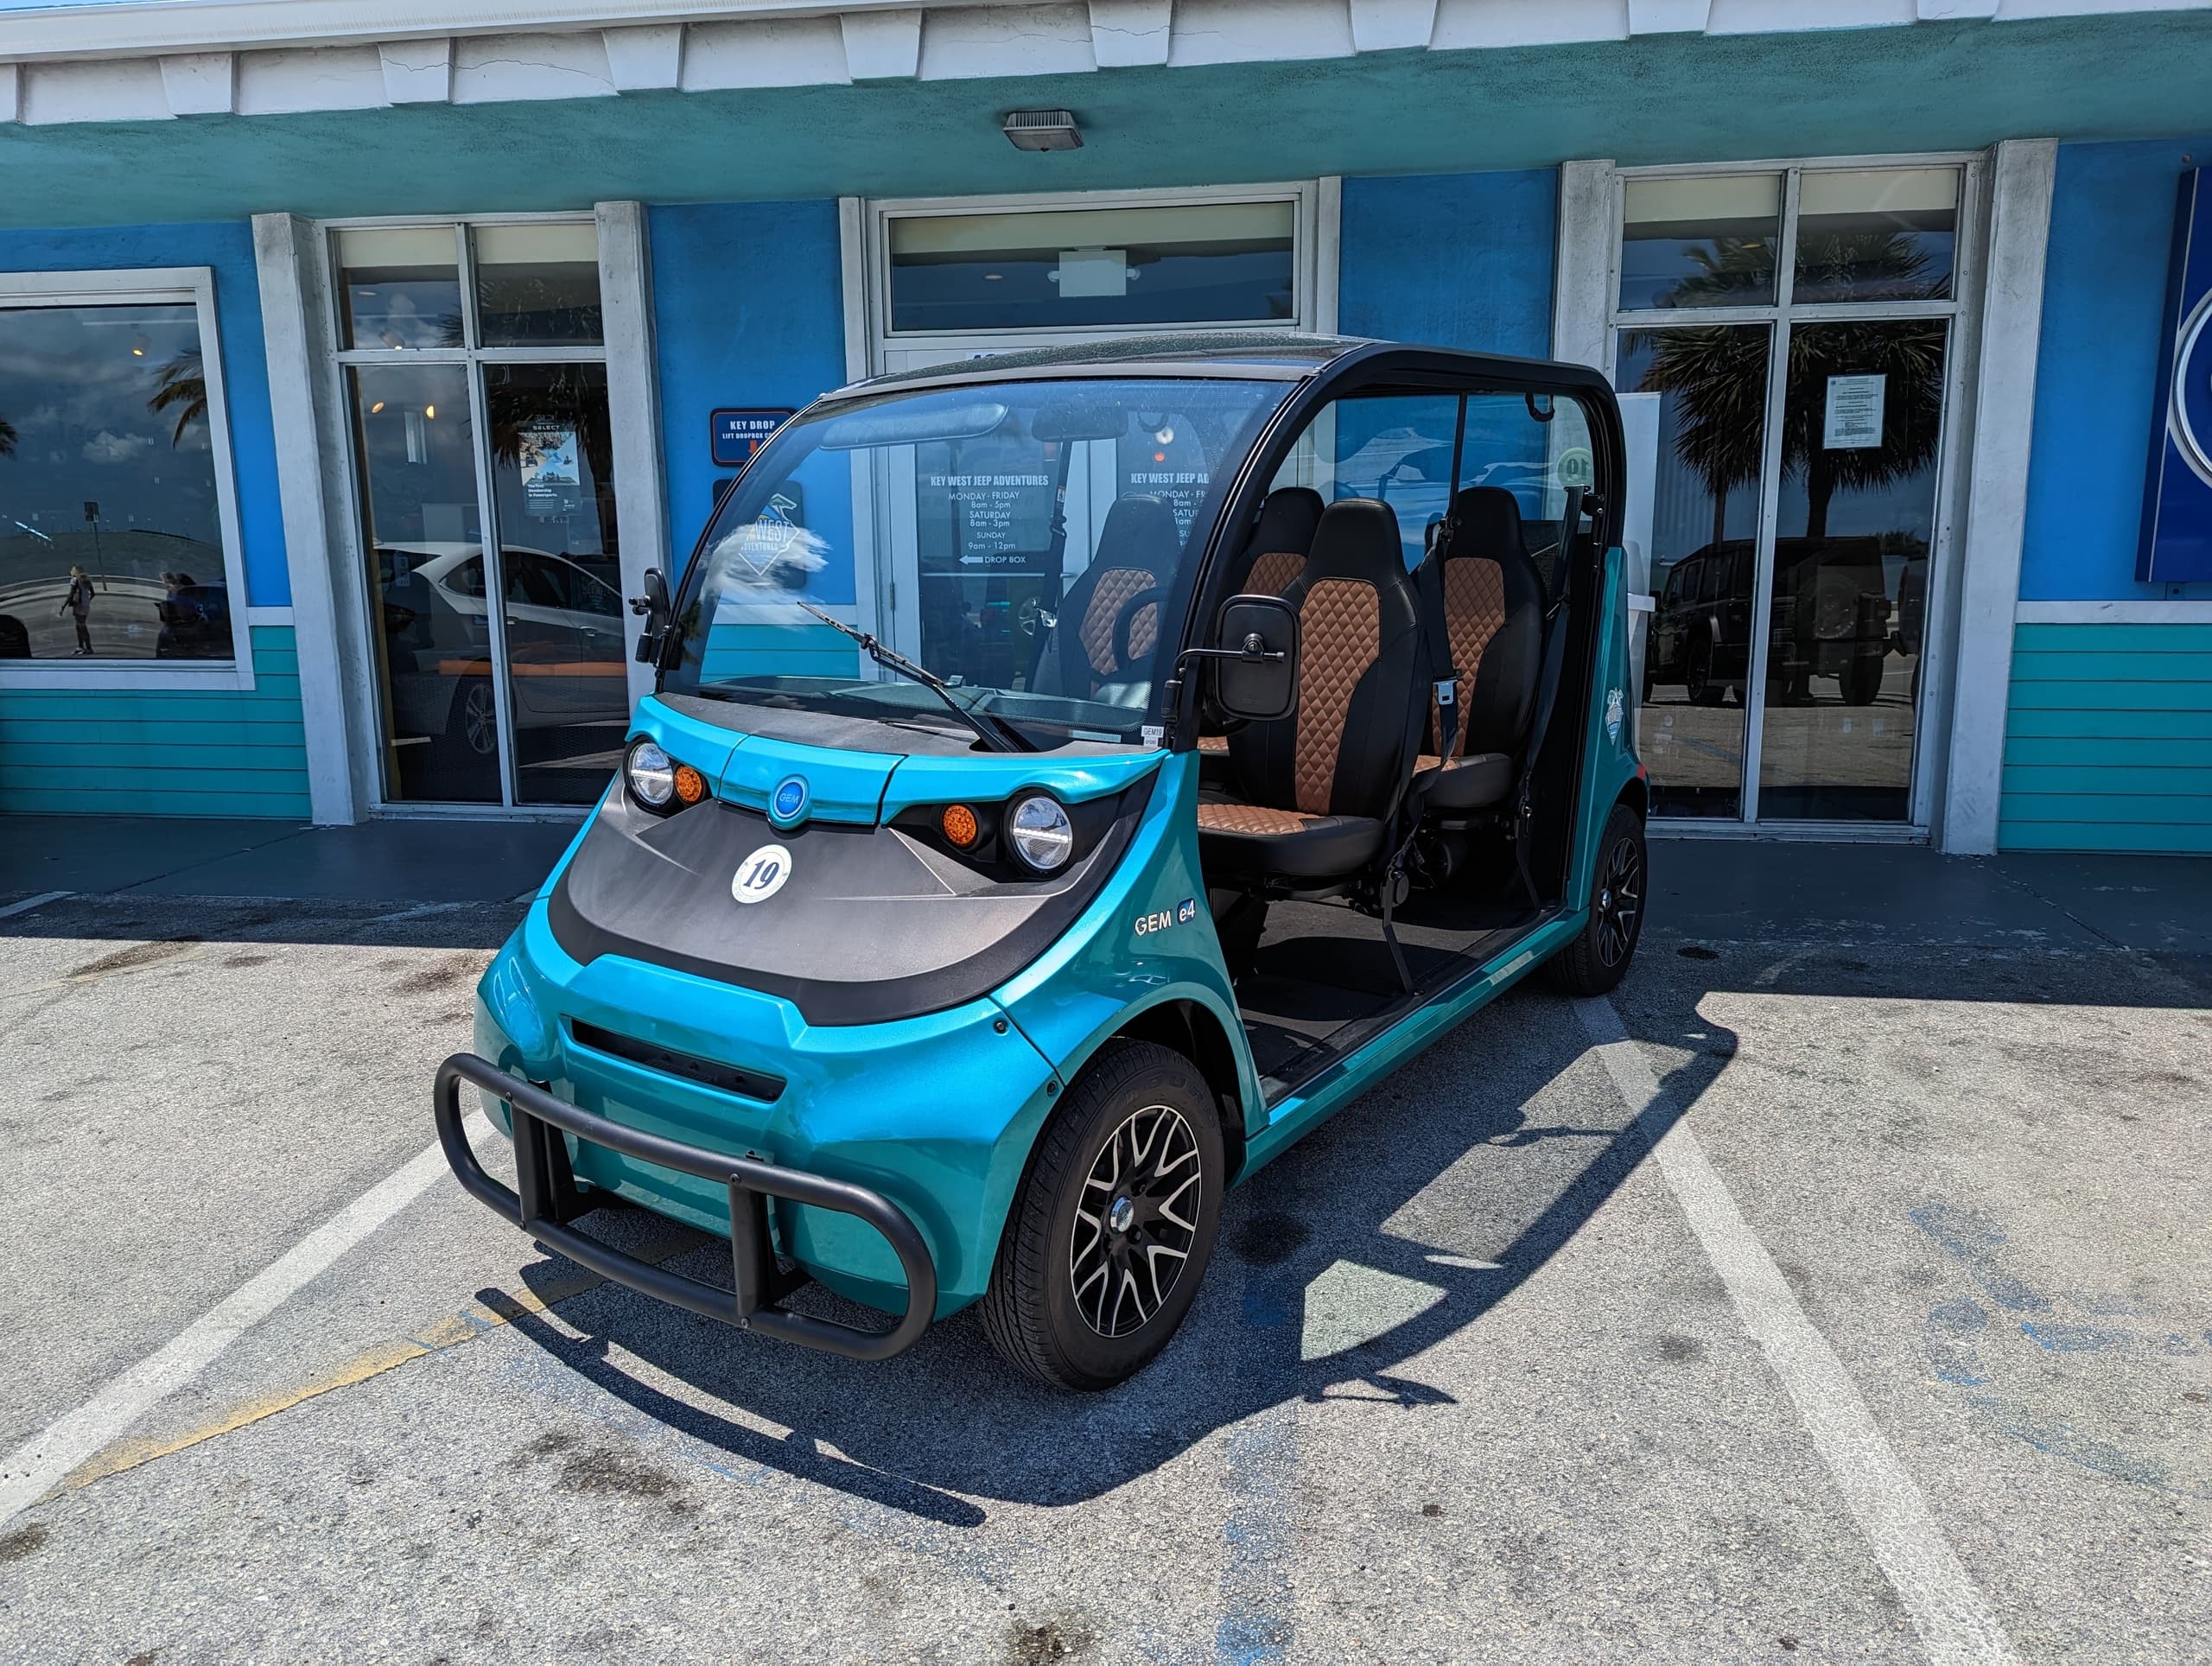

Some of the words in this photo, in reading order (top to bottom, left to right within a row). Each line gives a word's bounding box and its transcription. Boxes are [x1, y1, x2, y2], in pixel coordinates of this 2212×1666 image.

[729, 421, 747, 430] KEY
[749, 420, 775, 429] DROP
[931, 476, 949, 486] KEY
[948, 476, 972, 486] WEST
[973, 475, 992, 486] JEEP
[993, 475, 1049, 486] ADVENTURES
[1131, 473, 1148, 484] KEY
[1148, 473, 1174, 484] WEST
[1175, 473, 1196, 484] JEEP
[949, 492, 987, 500] MONDAY
[992, 491, 1020, 499] FRIDAY
[995, 501, 1011, 510] 5pm
[994, 519, 1010, 528] 3pm
[994, 542, 1016, 550] 12pm
[779, 792, 800, 804] GEM
[743, 859, 779, 890] 19
[1135, 910, 1172, 936] GEM
[1179, 899, 1195, 922] e4
